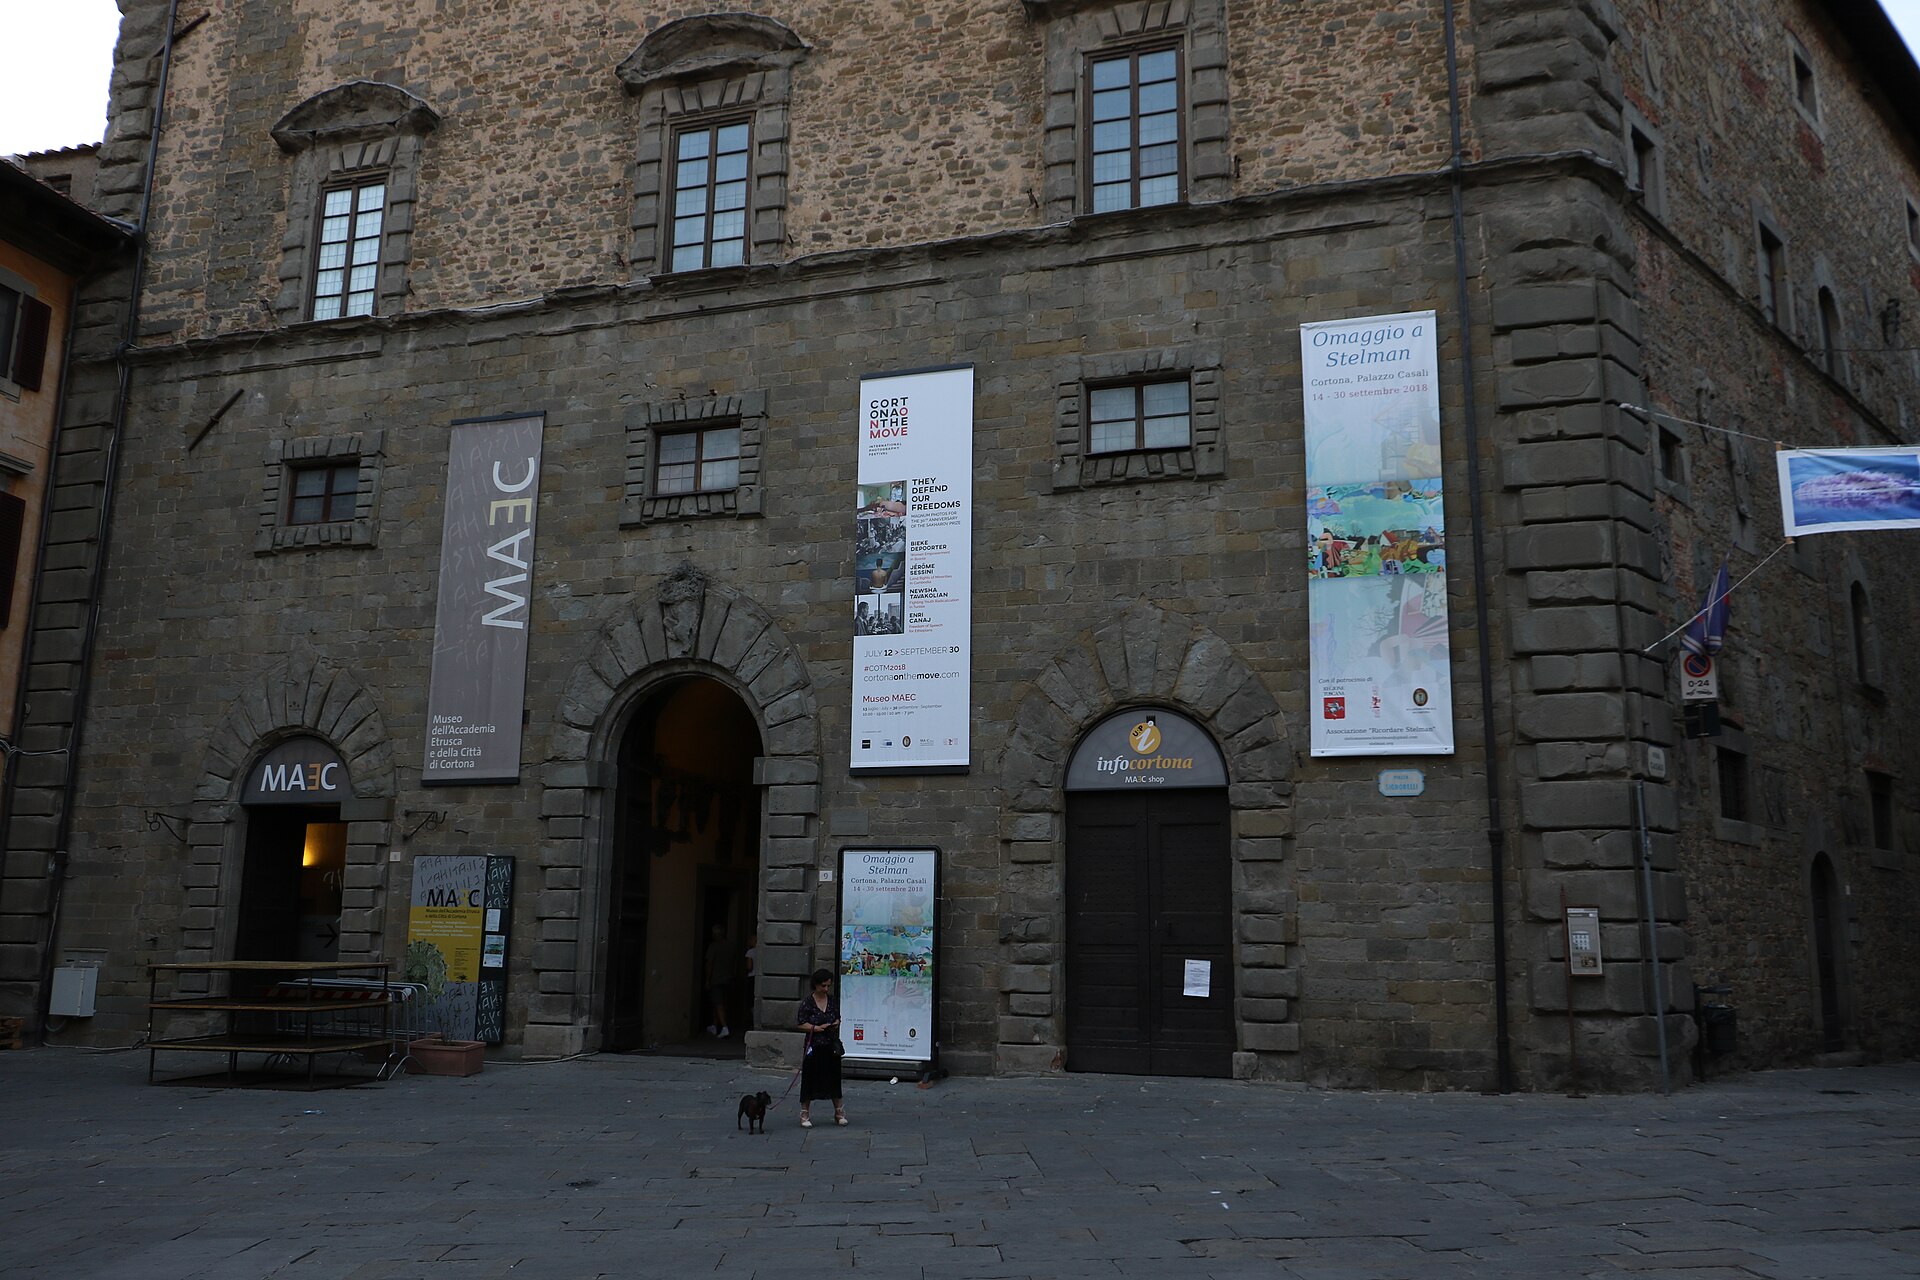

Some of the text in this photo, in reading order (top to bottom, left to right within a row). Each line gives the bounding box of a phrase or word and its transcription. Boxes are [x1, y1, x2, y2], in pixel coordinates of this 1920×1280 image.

[1313, 325, 1422, 346] Omaggio a
[1326, 348, 1410, 367] Stelman
[1311, 369, 1429, 387] Cortona, Palazzo Casali
[1334, 391, 1346, 399] 30
[1349, 387, 1400, 398] settembre
[1403, 384, 1428, 393] 2018
[870, 397, 908, 409] CORT
[870, 407, 908, 419] ONAO
[870, 417, 908, 429] NTHE
[870, 427, 908, 439] MOVE
[912, 477, 936, 486] THEY
[912, 485, 948, 494] DEFEND
[912, 501, 960, 511] FREEDOMS
[900, 647, 947, 656] SEPTEMBER
[864, 671, 960, 682] cortonaonthemove.com
[433, 715, 462, 724] Museo
[432, 724, 496, 735] dell'Accademia
[431, 737, 462, 746] Etrusca
[437, 748, 458, 757] della
[460, 747, 481, 756] Città
[430, 760, 474, 769] di Cortona
[1097, 754, 1193, 774] infocortona
[260, 762, 338, 792] MAEC
[1148, 775, 1164, 784] shop
[862, 855, 905, 865] Omaggio
[868, 866, 908, 874] Stelman
